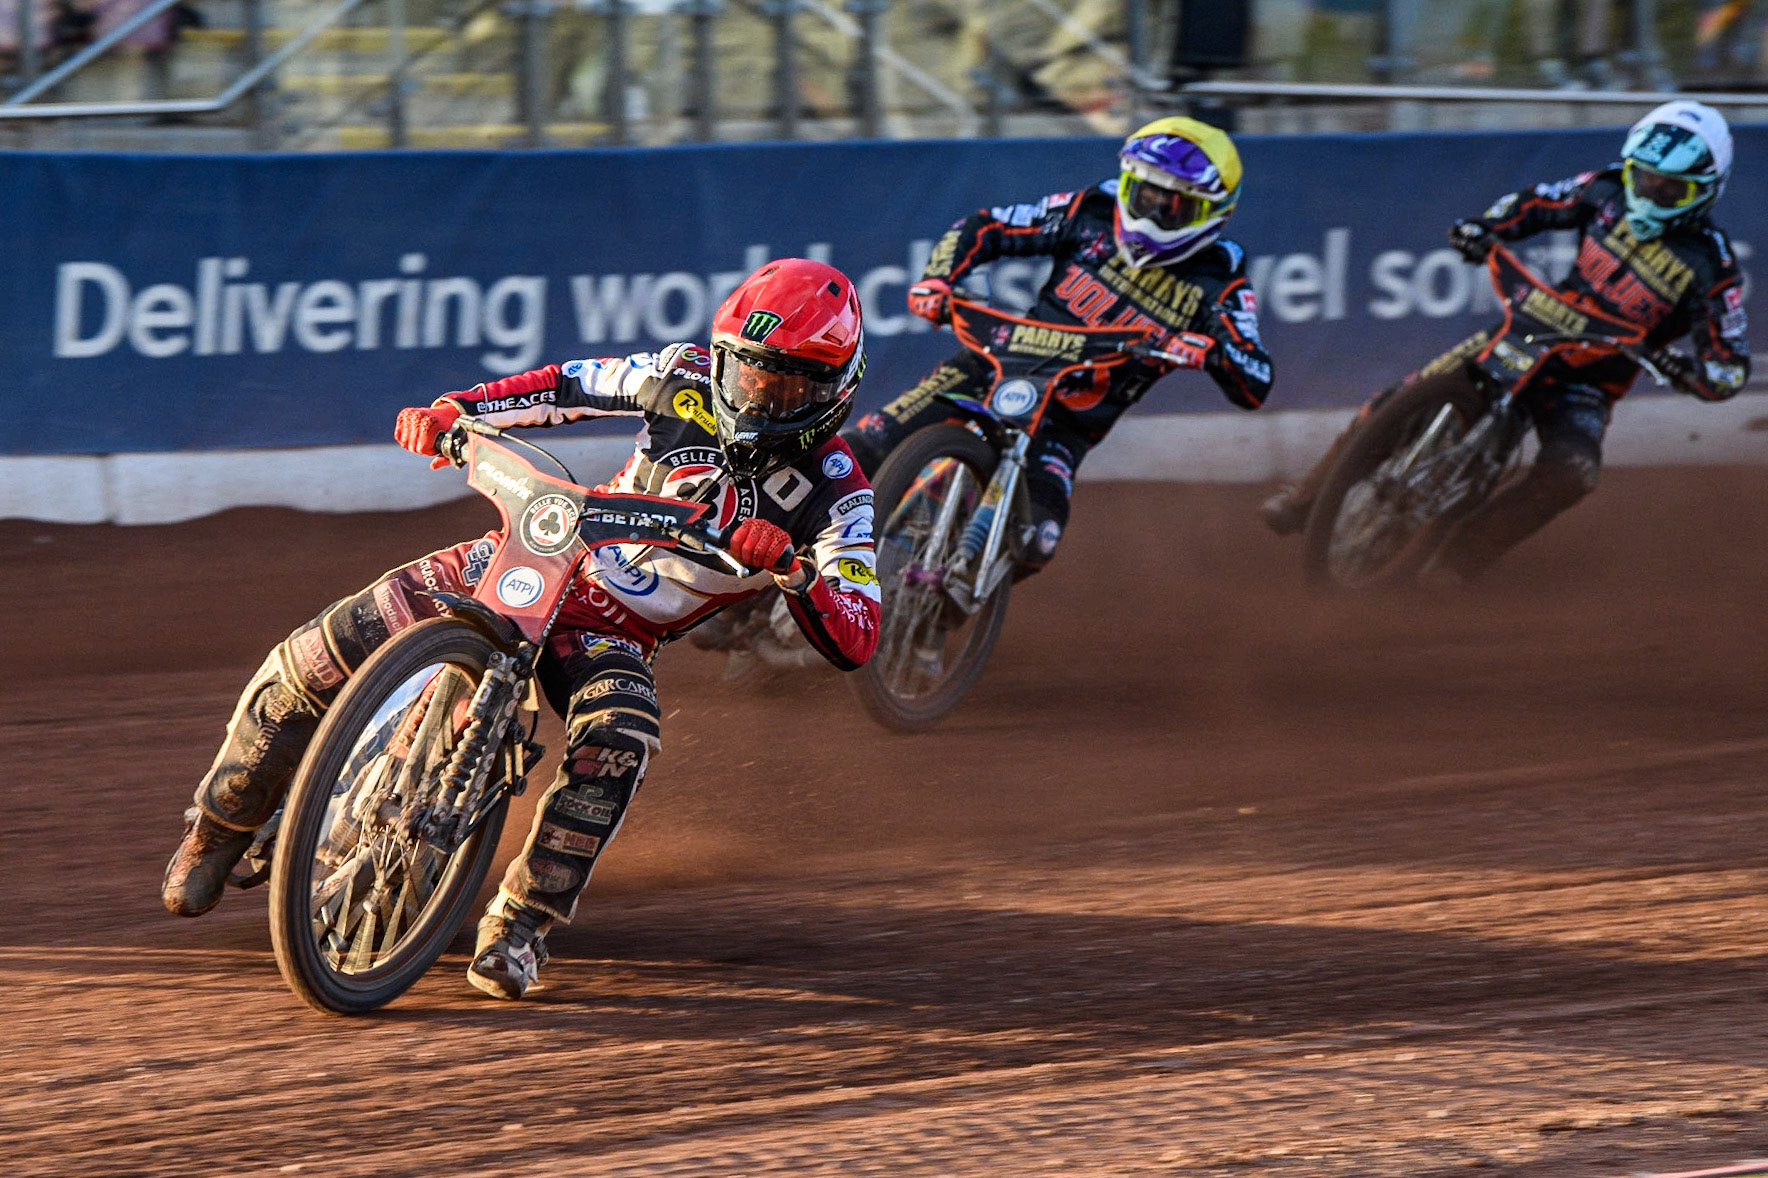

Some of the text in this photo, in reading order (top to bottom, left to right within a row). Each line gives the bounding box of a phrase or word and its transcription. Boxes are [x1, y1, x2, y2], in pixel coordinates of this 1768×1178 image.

[53, 252, 548, 374] Delivering
[570, 243, 833, 344] wor
[1011, 324, 1087, 354] PARRYS
[670, 452, 717, 467] BELLE
[530, 498, 552, 514] BELLE
[506, 578, 535, 597] ATPI
